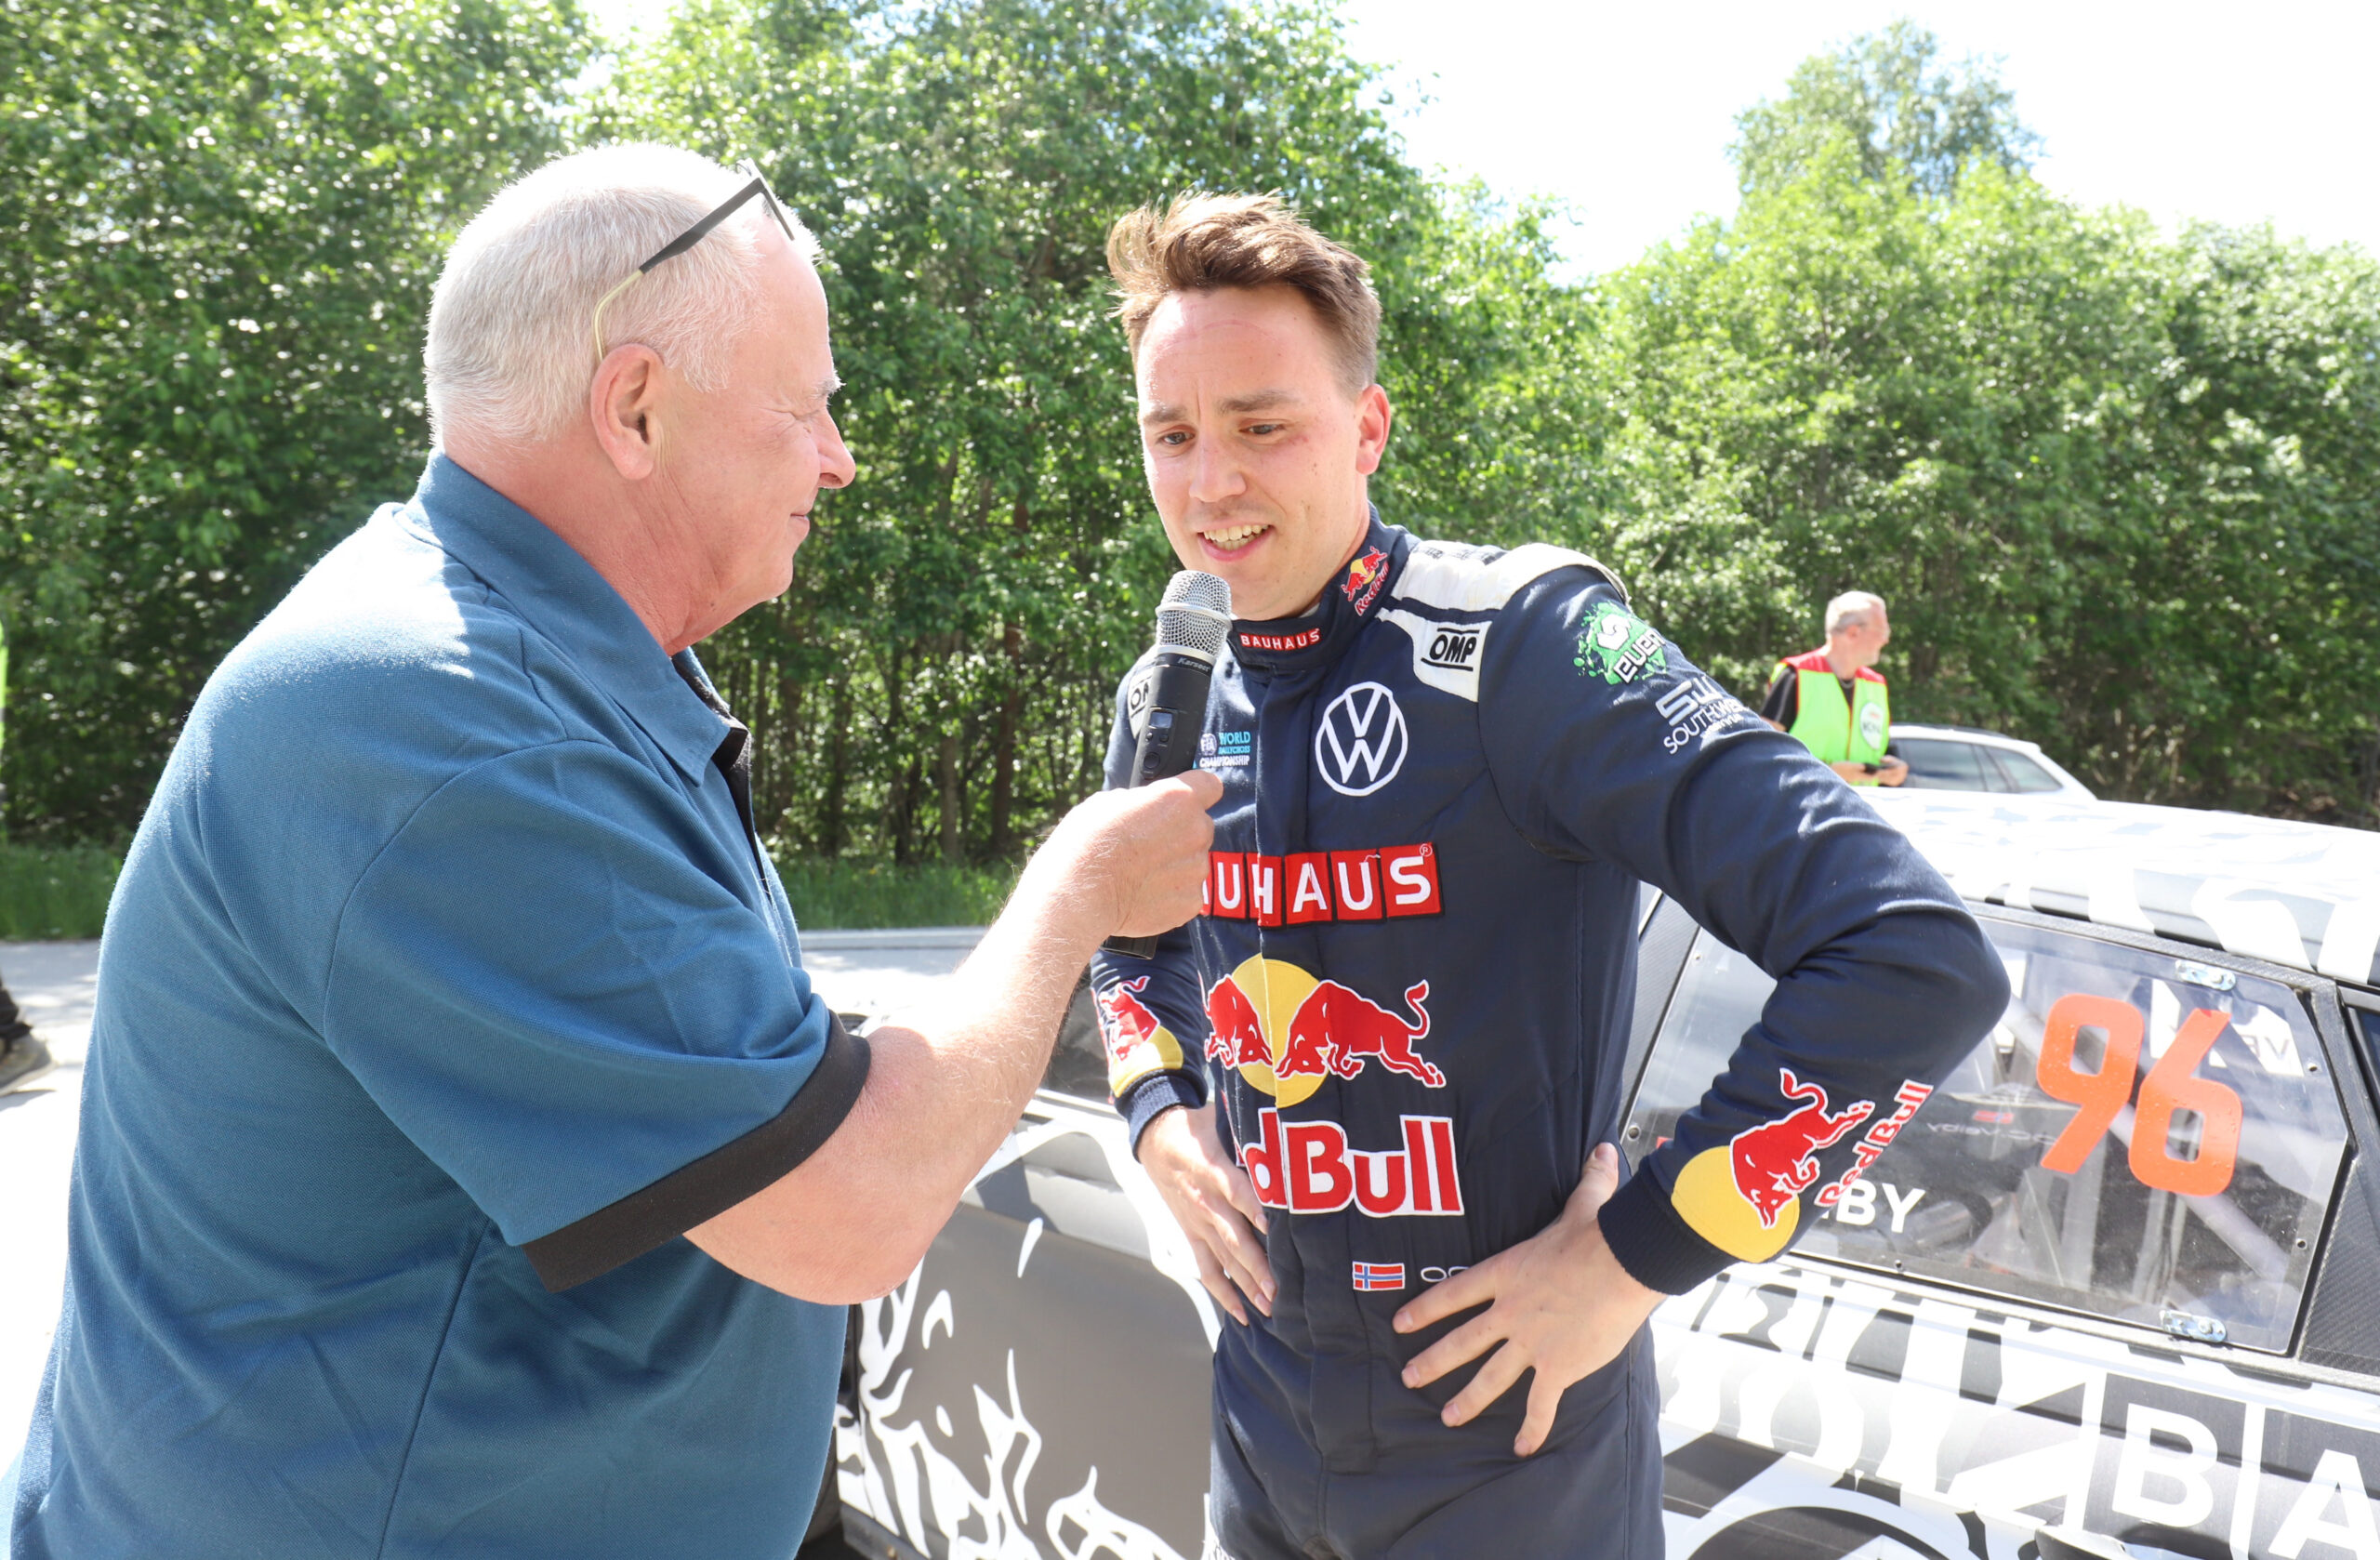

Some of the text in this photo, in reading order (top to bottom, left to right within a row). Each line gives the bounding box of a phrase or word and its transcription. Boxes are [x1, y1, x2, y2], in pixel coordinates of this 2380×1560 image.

[1240, 630, 1320, 650] BAUHAUS
[1430, 634, 1477, 663] OMP
[1218, 731, 1250, 745] WORLD
[1199, 755, 1250, 768] CHAMPIONSHIP
[1202, 855, 1432, 914] UHAUS
[2036, 993, 2242, 1197] 96
[1822, 1179, 1926, 1234] BY
